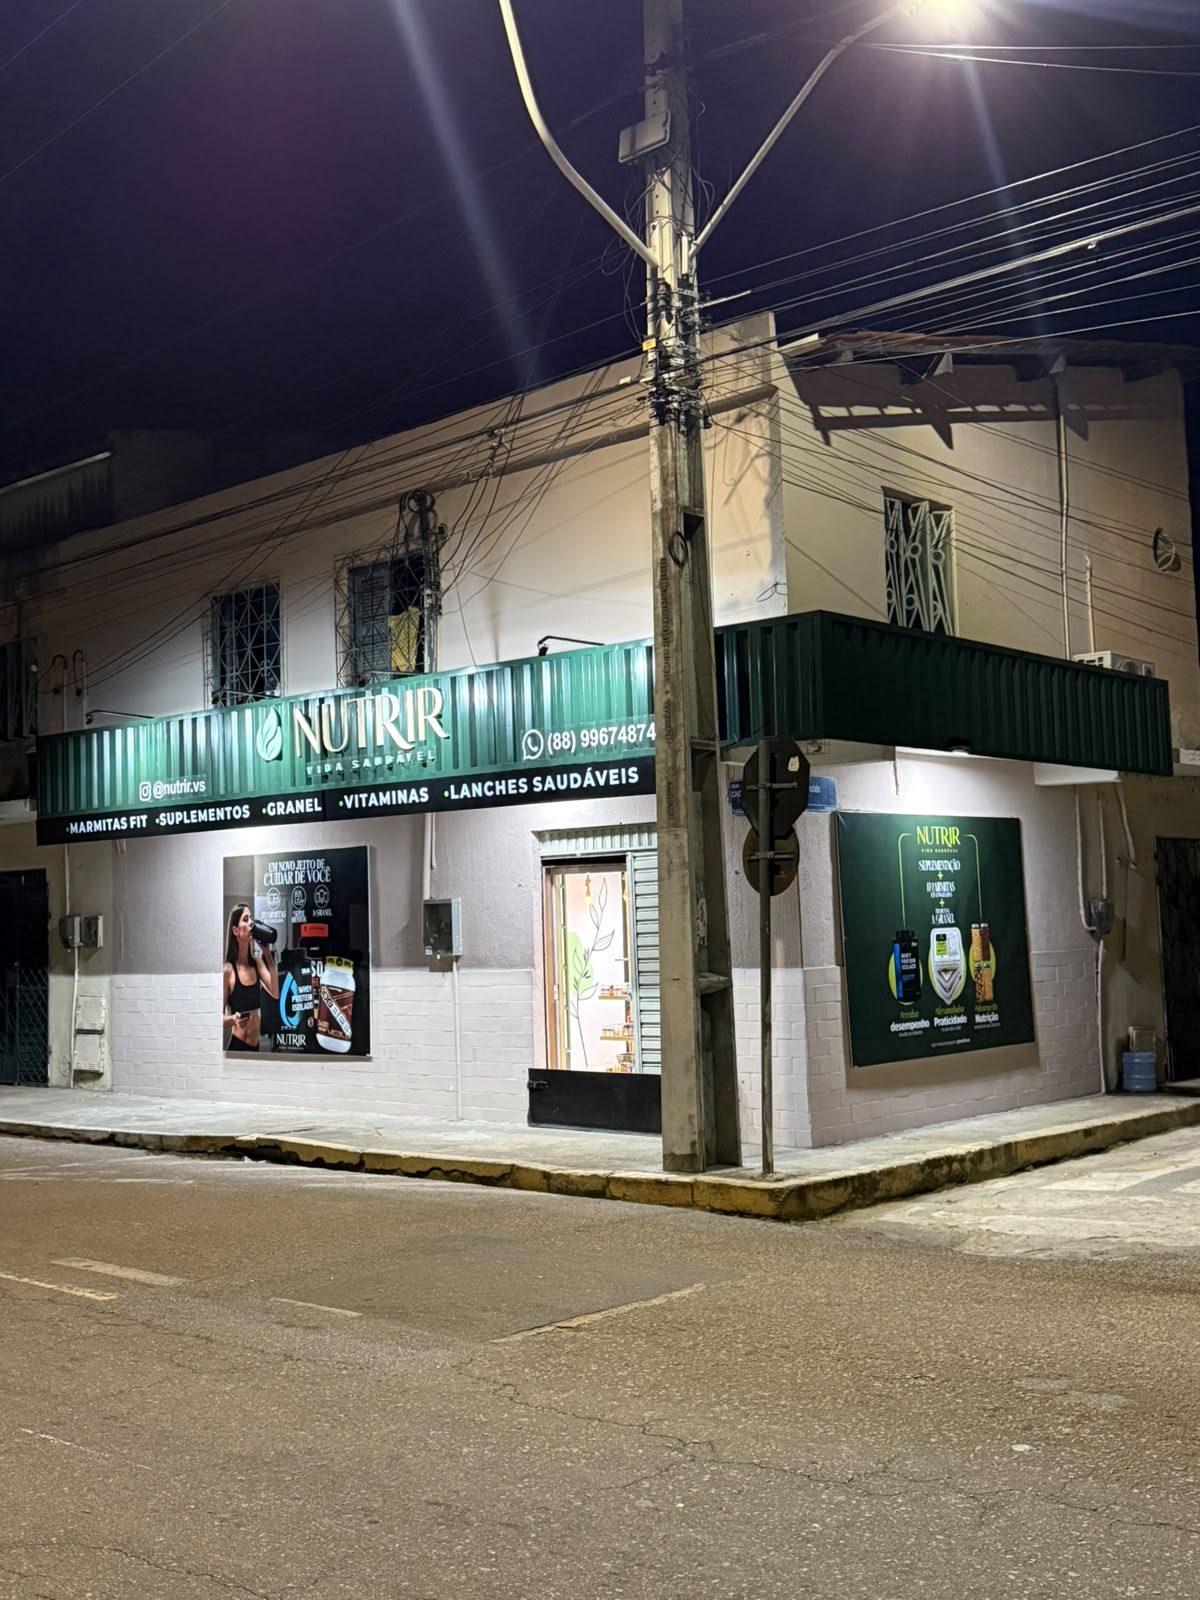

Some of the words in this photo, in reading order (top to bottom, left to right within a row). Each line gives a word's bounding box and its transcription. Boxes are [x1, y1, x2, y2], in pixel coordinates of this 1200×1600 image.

[293, 687, 450, 757] NUTRIR
[547, 730, 576, 755] (88)
[580, 722, 656, 748] 99674874
[152, 780, 206, 799] @nutrir.vs
[69, 817, 127, 834] MARMITAS
[130, 815, 148, 829] FIT
[159, 805, 250, 826] SUPLEMENTOS
[267, 798, 323, 816] GRANEL
[343, 787, 429, 809] VITAMINAS
[449, 778, 528, 800] LANCHES
[532, 767, 640, 793] SAUDÁVEIS
[916, 825, 961, 848] NUTRIR
[278, 860, 296, 872] NOVO
[296, 859, 316, 870] JEITO
[316, 859, 326, 869] DE
[263, 871, 294, 886] CUIDAR
[294, 870, 306, 884] DE
[306, 865, 331, 883] VOCÊ
[890, 1018, 930, 1032] desempenho
[934, 1014, 967, 1027] Praticidade
[975, 1012, 999, 1024] Nutrição
[276, 1033, 307, 1046] NUTRIR
